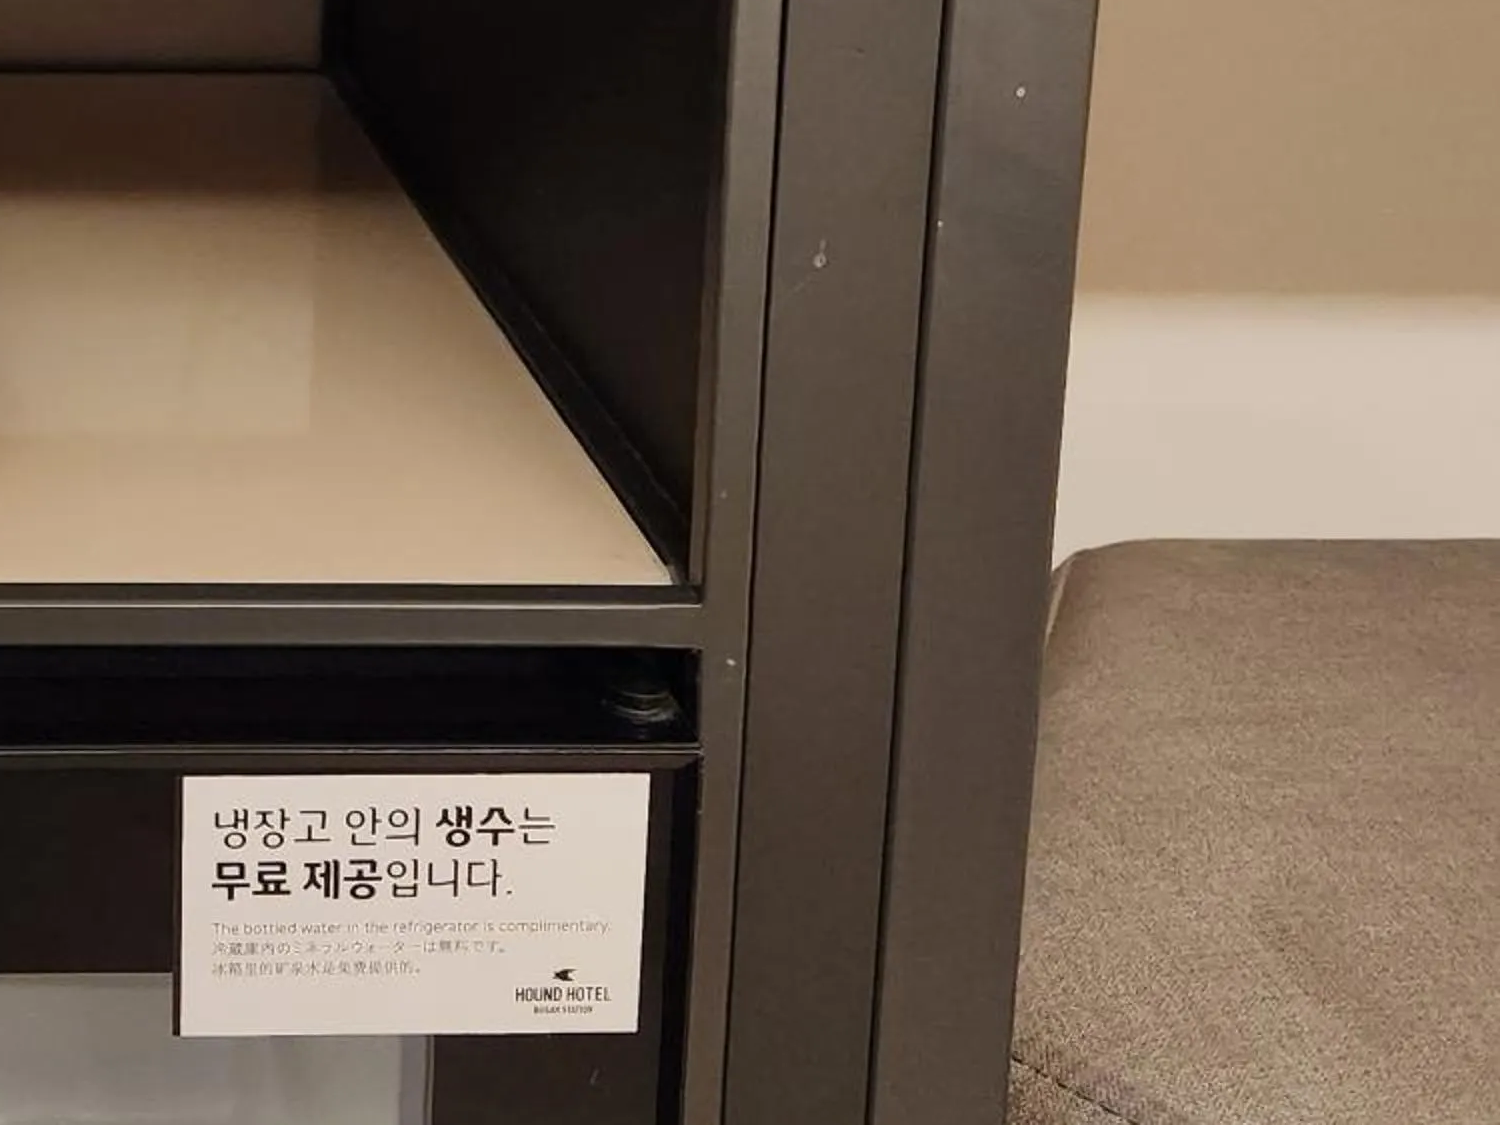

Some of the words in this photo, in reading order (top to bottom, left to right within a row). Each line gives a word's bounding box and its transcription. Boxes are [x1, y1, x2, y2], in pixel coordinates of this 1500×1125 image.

[214, 807, 331, 850] 냉장고
[345, 806, 421, 847] 안의
[435, 804, 556, 848] 생수는
[211, 860, 292, 902] 무료
[302, 858, 513, 900] 제공입니다.
[213, 922, 239, 935] The
[243, 922, 297, 935] bottled
[301, 922, 341, 934] water
[347, 922, 359, 934] in
[364, 922, 389, 934] the
[393, 920, 479, 936] refrigerator
[483, 921, 495, 933] is
[515, 986, 563, 1002] HOUND
[566, 986, 611, 1002] HOTEL
